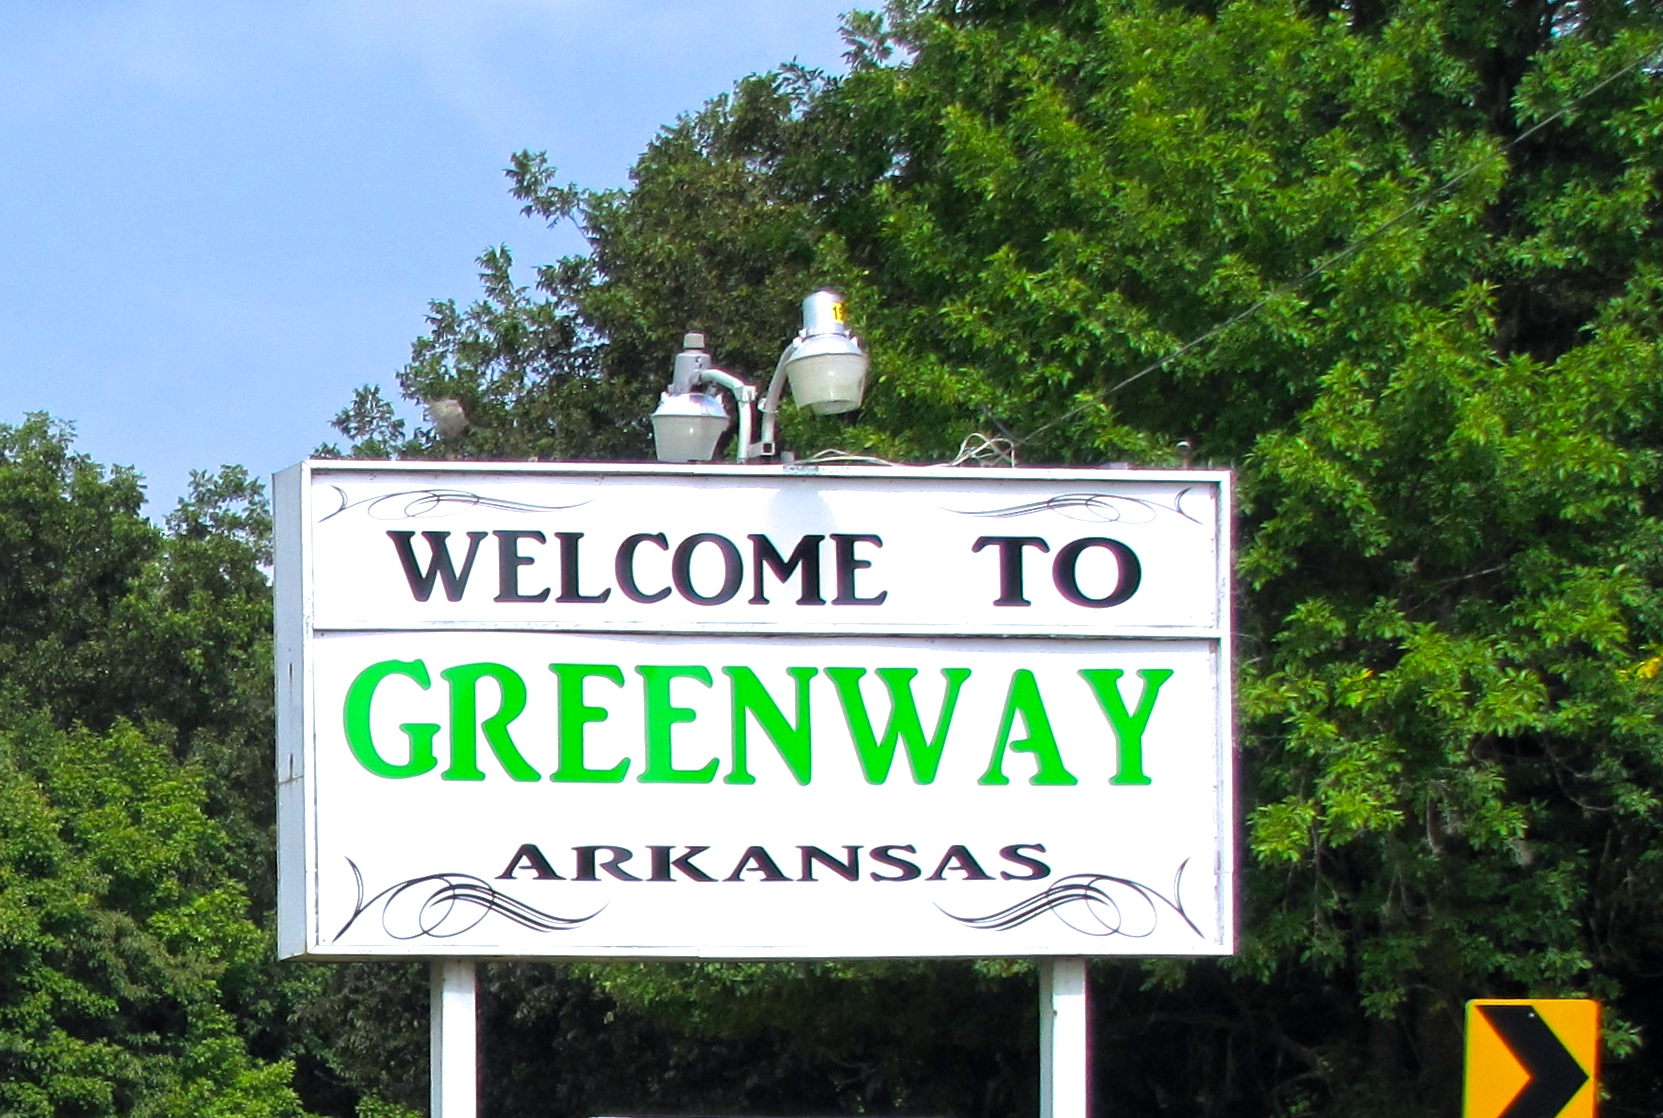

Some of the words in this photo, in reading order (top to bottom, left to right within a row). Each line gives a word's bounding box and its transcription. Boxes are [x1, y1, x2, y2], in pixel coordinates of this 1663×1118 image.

[385, 529, 889, 607] WELCOME
[972, 535, 1142, 609] TO
[342, 657, 1175, 787] GREENWAY
[497, 842, 1052, 883] ARKANSAS
